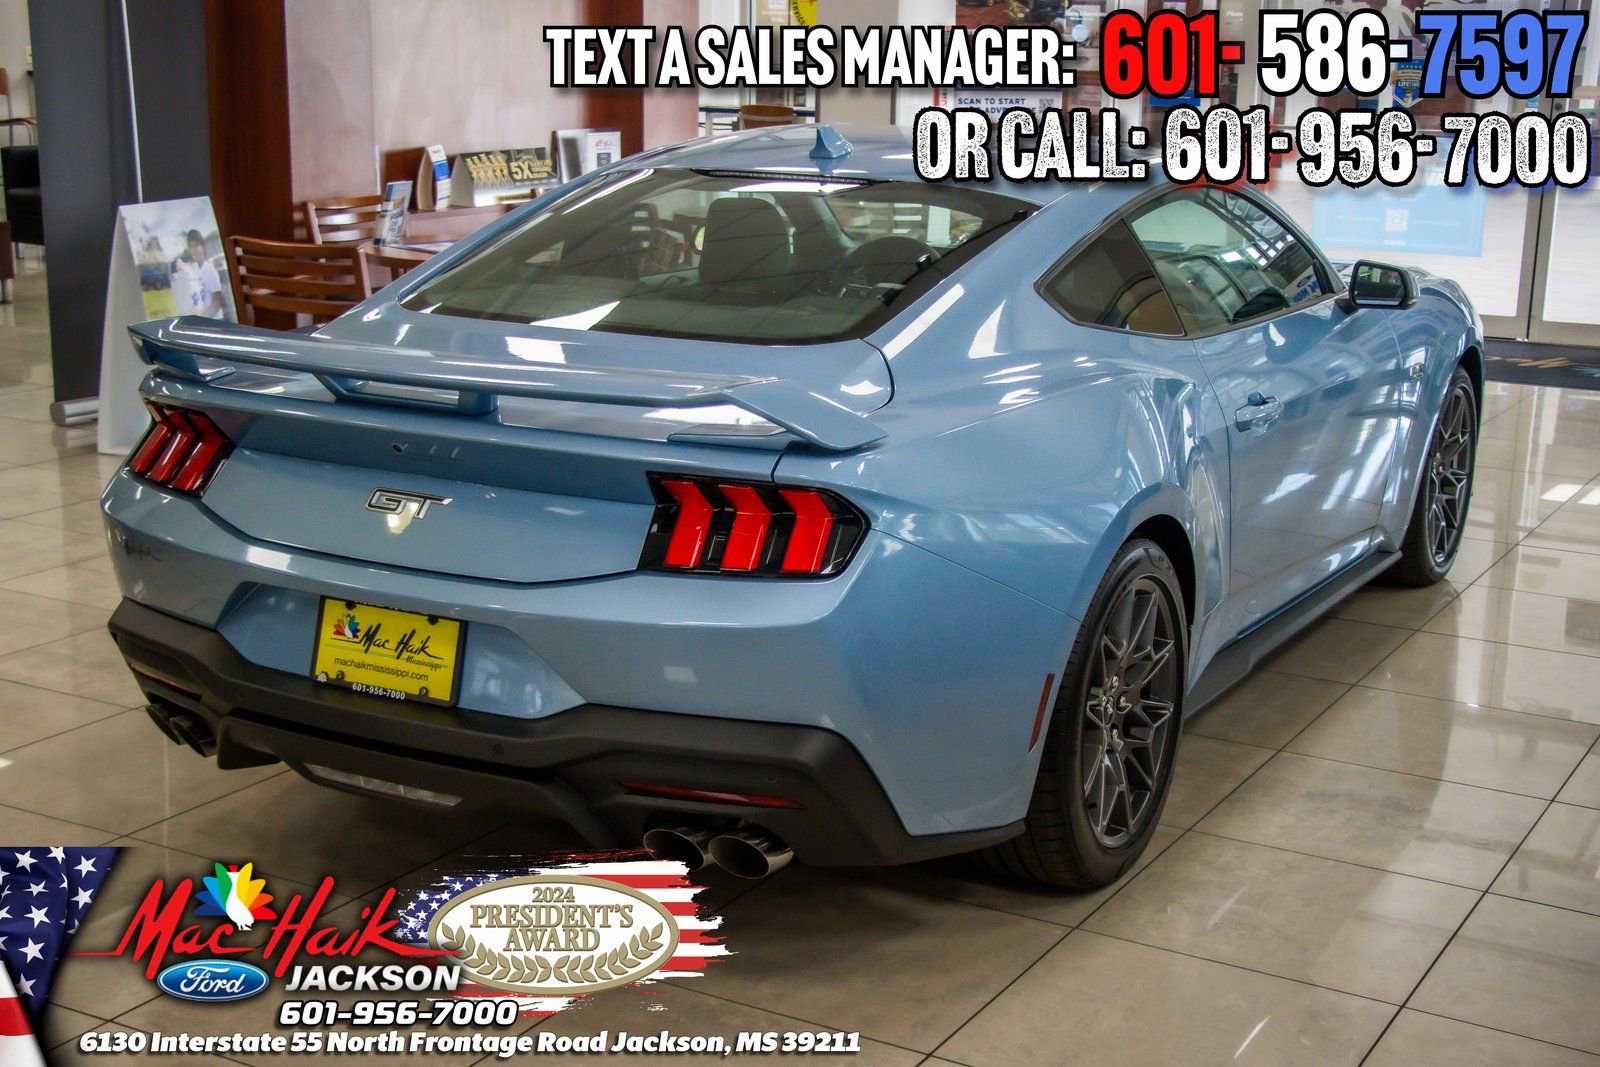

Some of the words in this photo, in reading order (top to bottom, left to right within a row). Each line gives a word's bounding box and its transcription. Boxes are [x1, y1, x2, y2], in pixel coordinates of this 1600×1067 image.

[366, 486, 454, 520] GT
[345, 623, 391, 654] Mac
[394, 629, 440, 660] Haik
[334, 656, 429, 682] machaikmississippi.com
[352, 682, 406, 700] 601-956-7000
